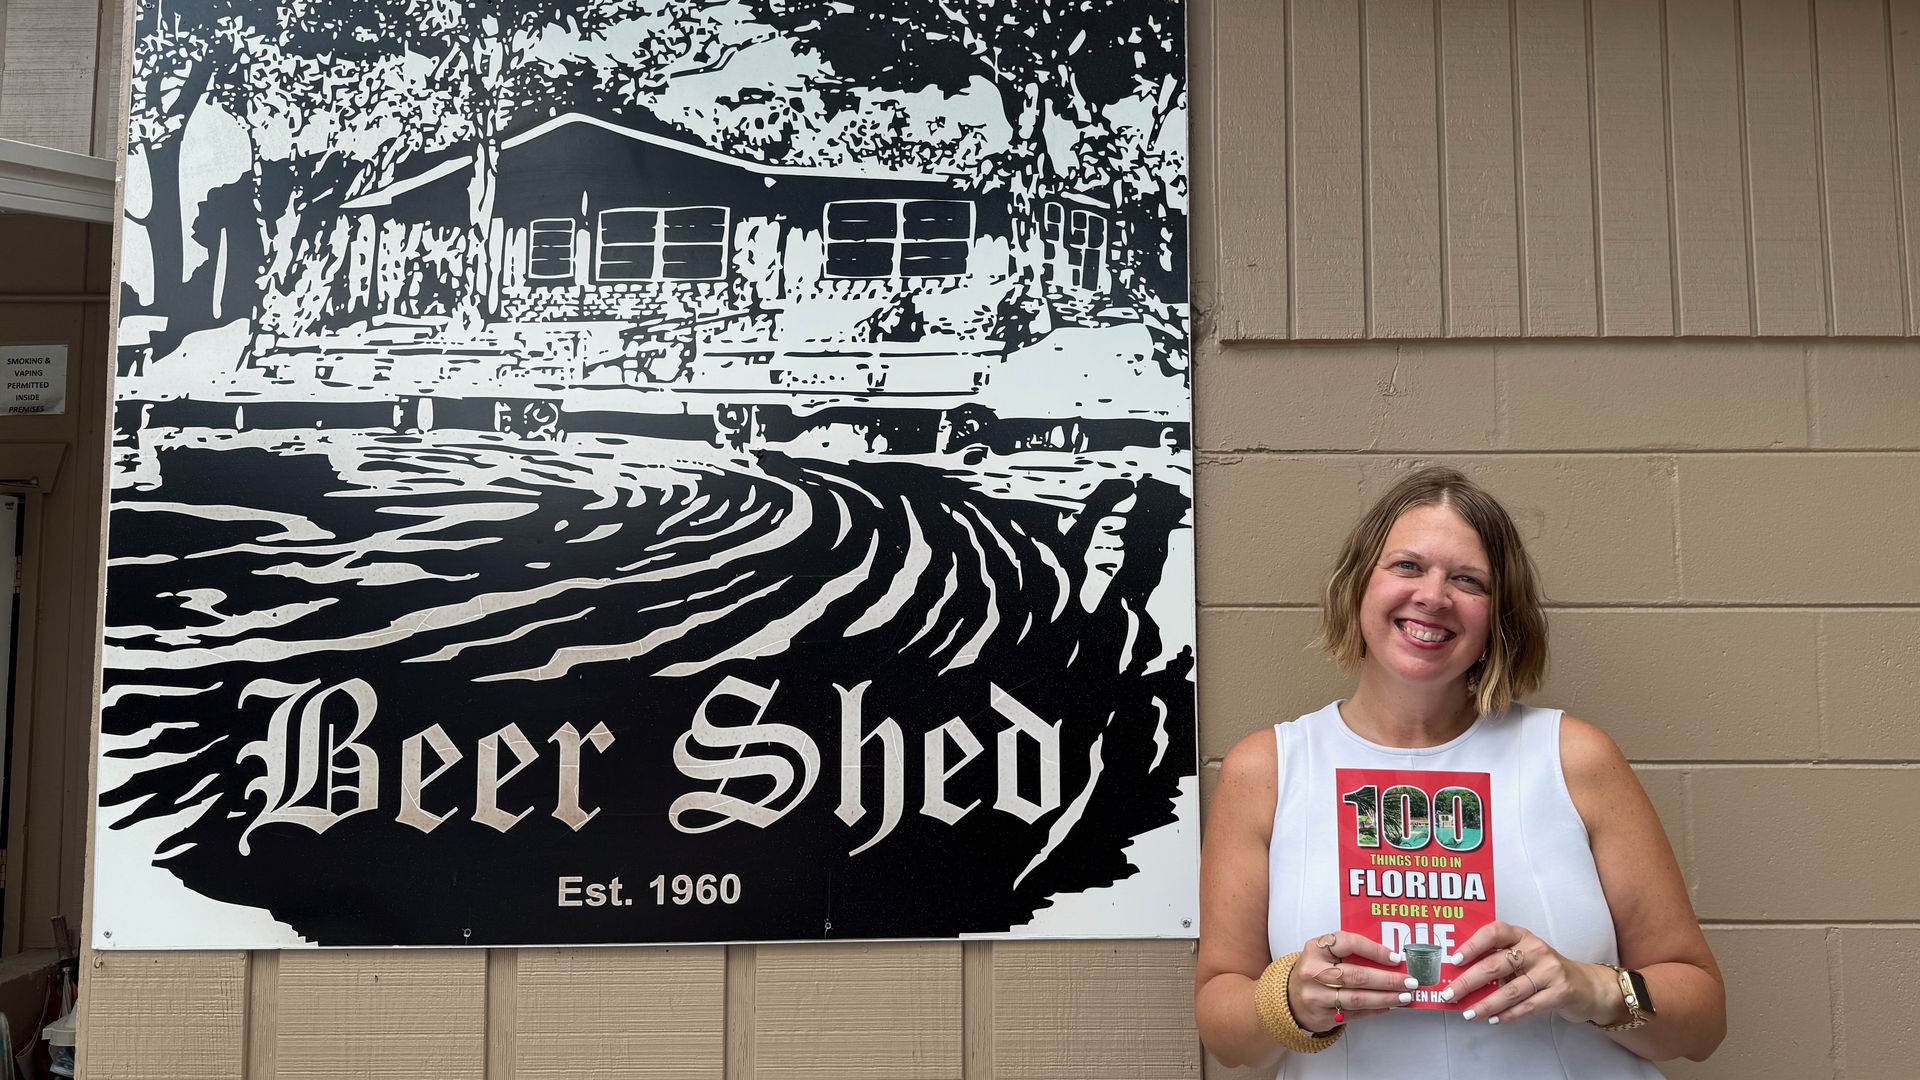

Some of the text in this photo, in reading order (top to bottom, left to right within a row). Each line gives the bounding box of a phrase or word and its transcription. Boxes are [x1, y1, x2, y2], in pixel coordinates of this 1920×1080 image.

[7, 357, 43, 365] SMOKING
[14, 369, 43, 377] VAPING
[8, 405, 45, 413] PREMISES
[236, 675, 1062, 857] Beer Shed
[1343, 785, 1484, 851] 100
[1370, 853, 1462, 868] THINGS TO DO IN
[557, 873, 742, 907] Est. 1960
[1349, 868, 1487, 901] FLORIDA
[1371, 902, 1464, 919] BEFORE YOU
